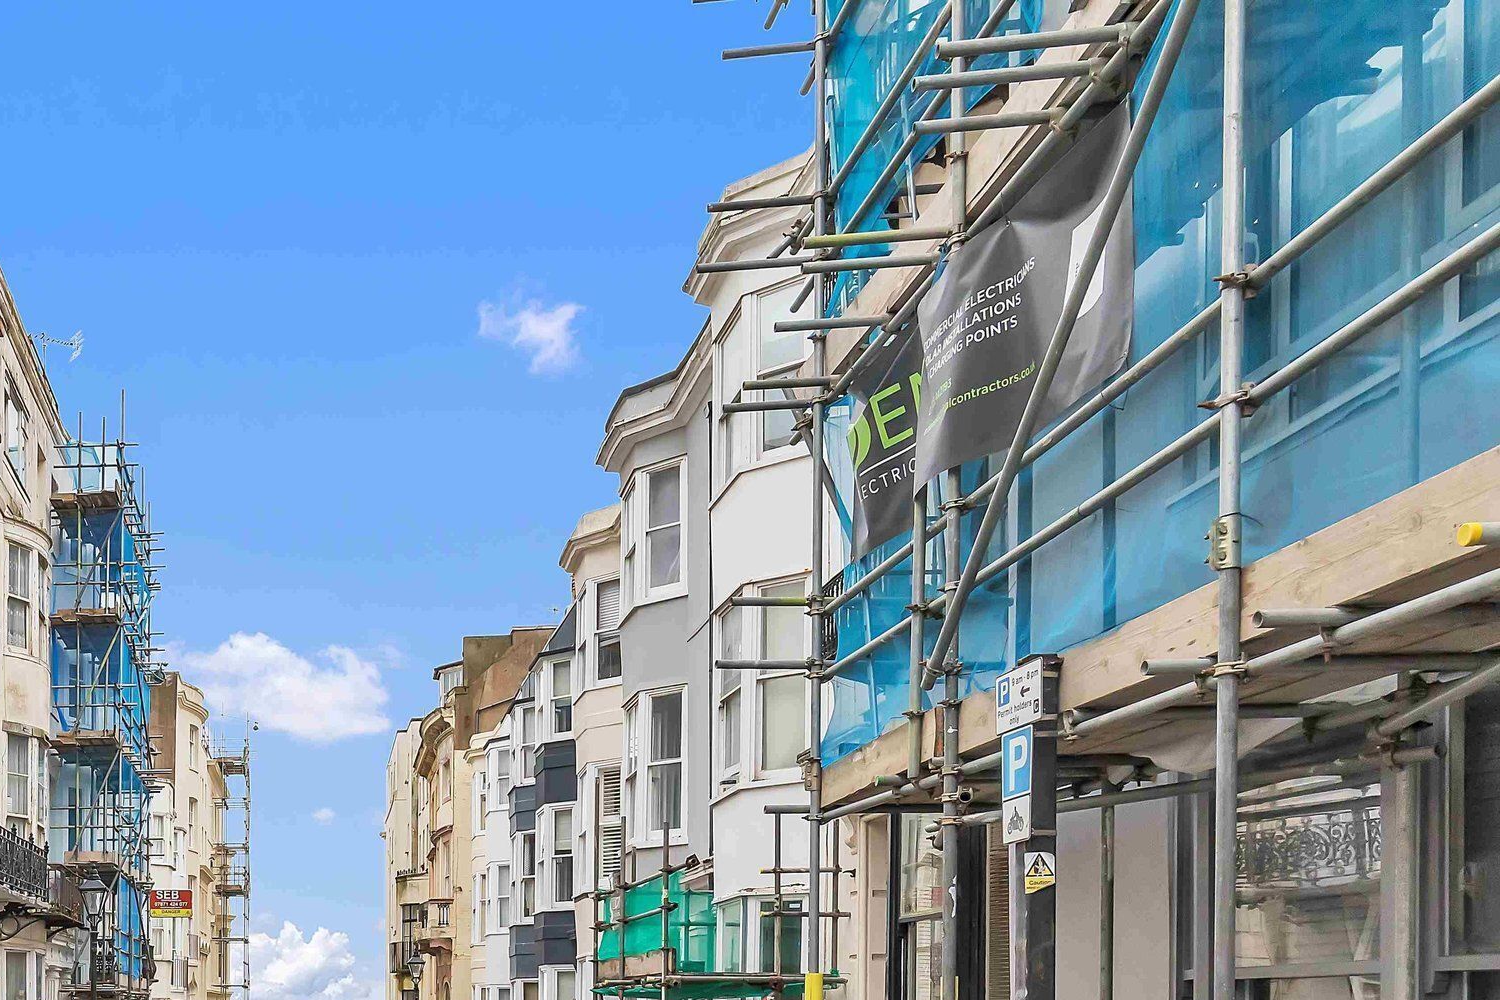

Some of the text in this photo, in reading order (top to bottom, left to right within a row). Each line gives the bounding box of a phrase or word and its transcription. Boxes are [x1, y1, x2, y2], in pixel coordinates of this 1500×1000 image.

[965, 314, 1019, 348] POINTS
[998, 707, 1013, 719] Permit
[1014, 699, 1032, 712] holders
[1009, 716, 1020, 725] only
[1009, 734, 1029, 792] P
[156, 890, 180, 900] SEB
